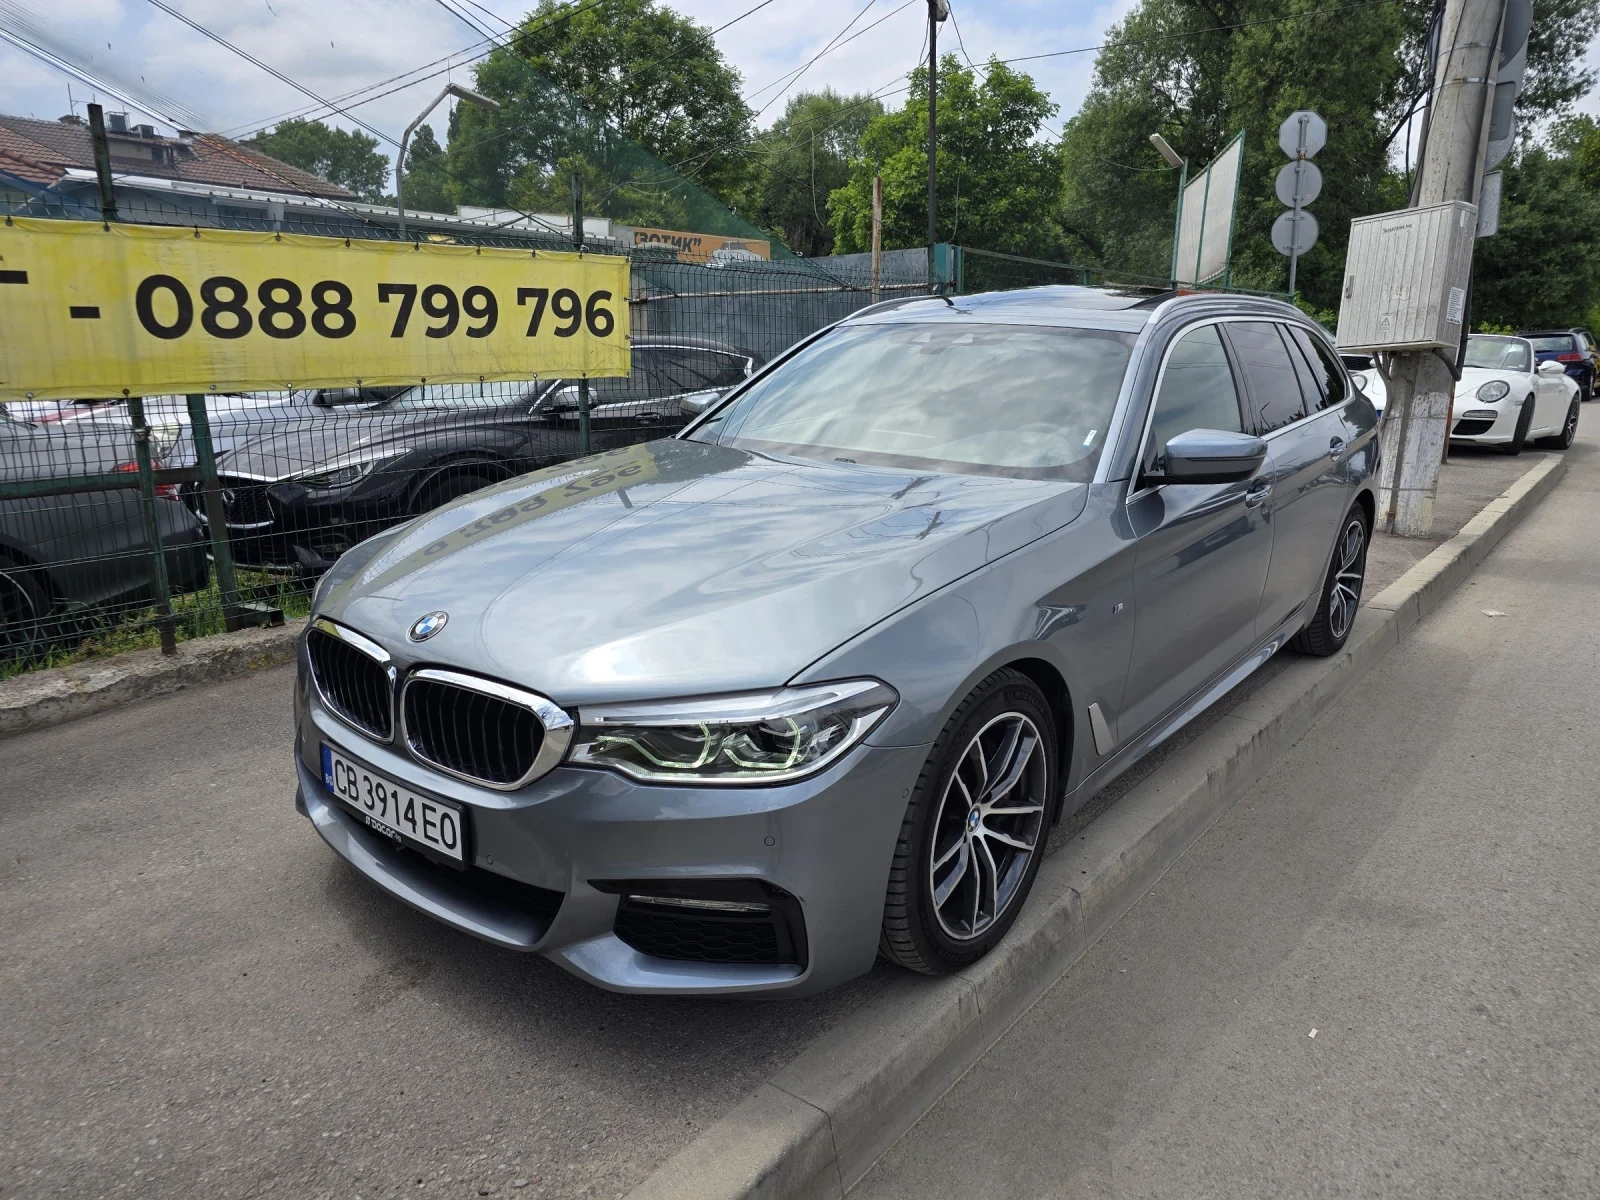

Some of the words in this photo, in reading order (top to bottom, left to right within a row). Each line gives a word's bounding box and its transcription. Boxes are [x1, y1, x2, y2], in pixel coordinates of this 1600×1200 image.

[135, 273, 357, 340] 0888
[377, 282, 500, 339] 799
[516, 286, 616, 338] 796
